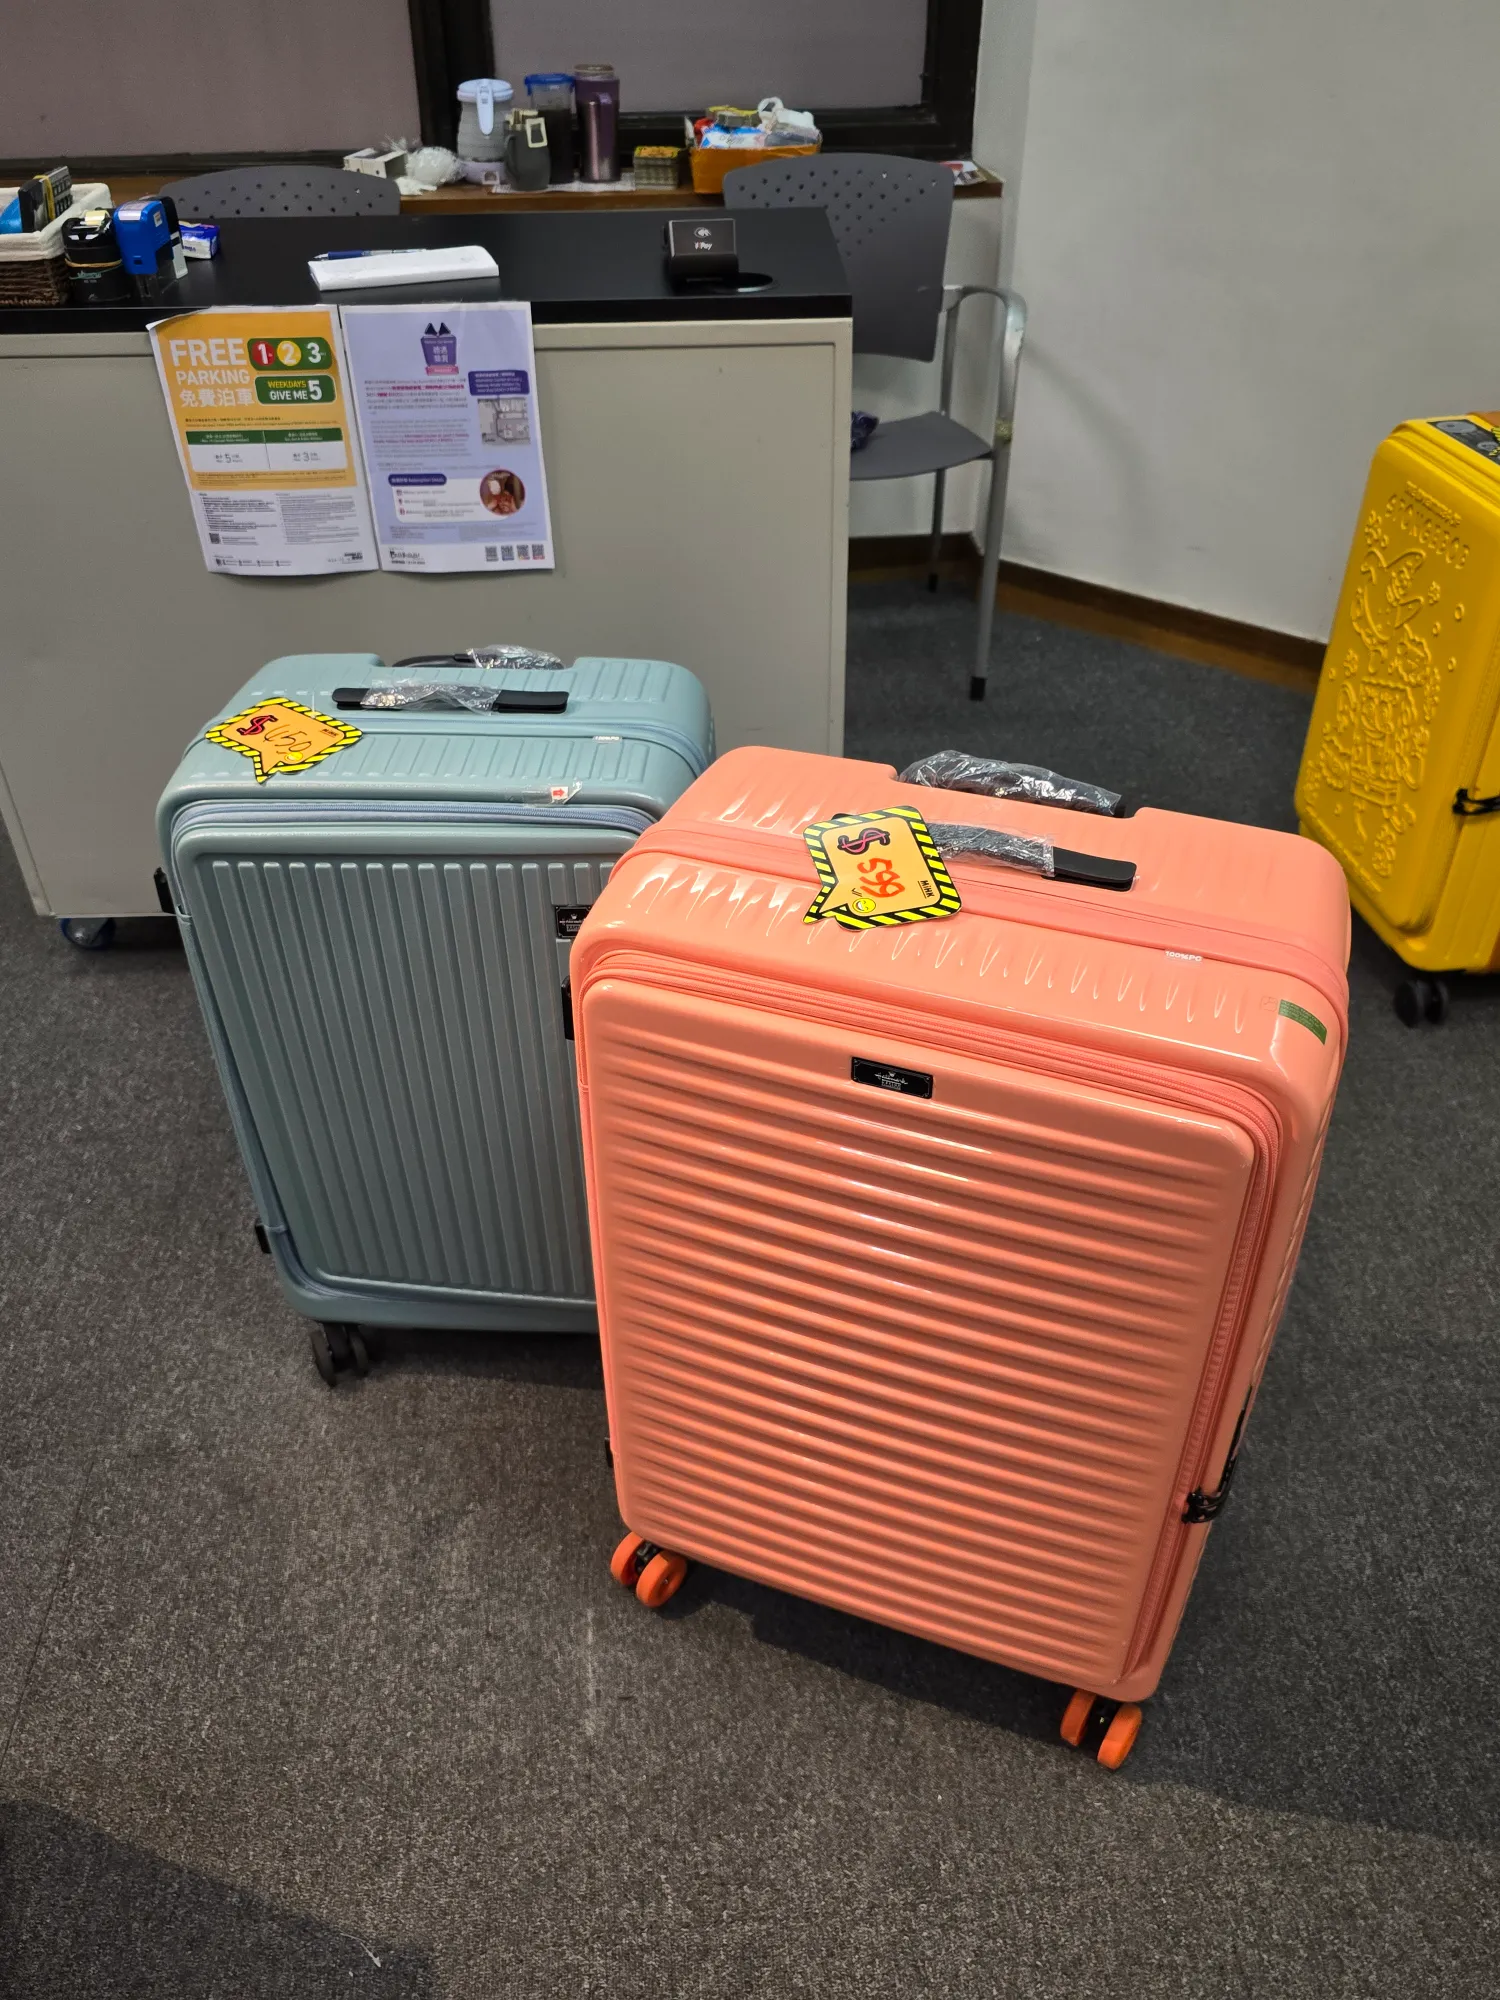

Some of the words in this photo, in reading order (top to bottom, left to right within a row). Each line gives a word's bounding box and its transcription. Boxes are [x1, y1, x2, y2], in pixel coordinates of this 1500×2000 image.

[169, 338, 247, 367] FREE
[257, 343, 269, 365] 1
[282, 343, 297, 364] 2
[307, 342, 322, 364] 3
[175, 368, 251, 386] PARKING
[267, 380, 307, 388] WEEKDAYS
[179, 388, 255, 408] 免費泊車
[269, 390, 291, 401] GIVE
[293, 390, 308, 400] ME
[308, 379, 322, 401] 5
[236, 714, 279, 736] $
[836, 827, 891, 855] $
[856, 857, 906, 898] 599
